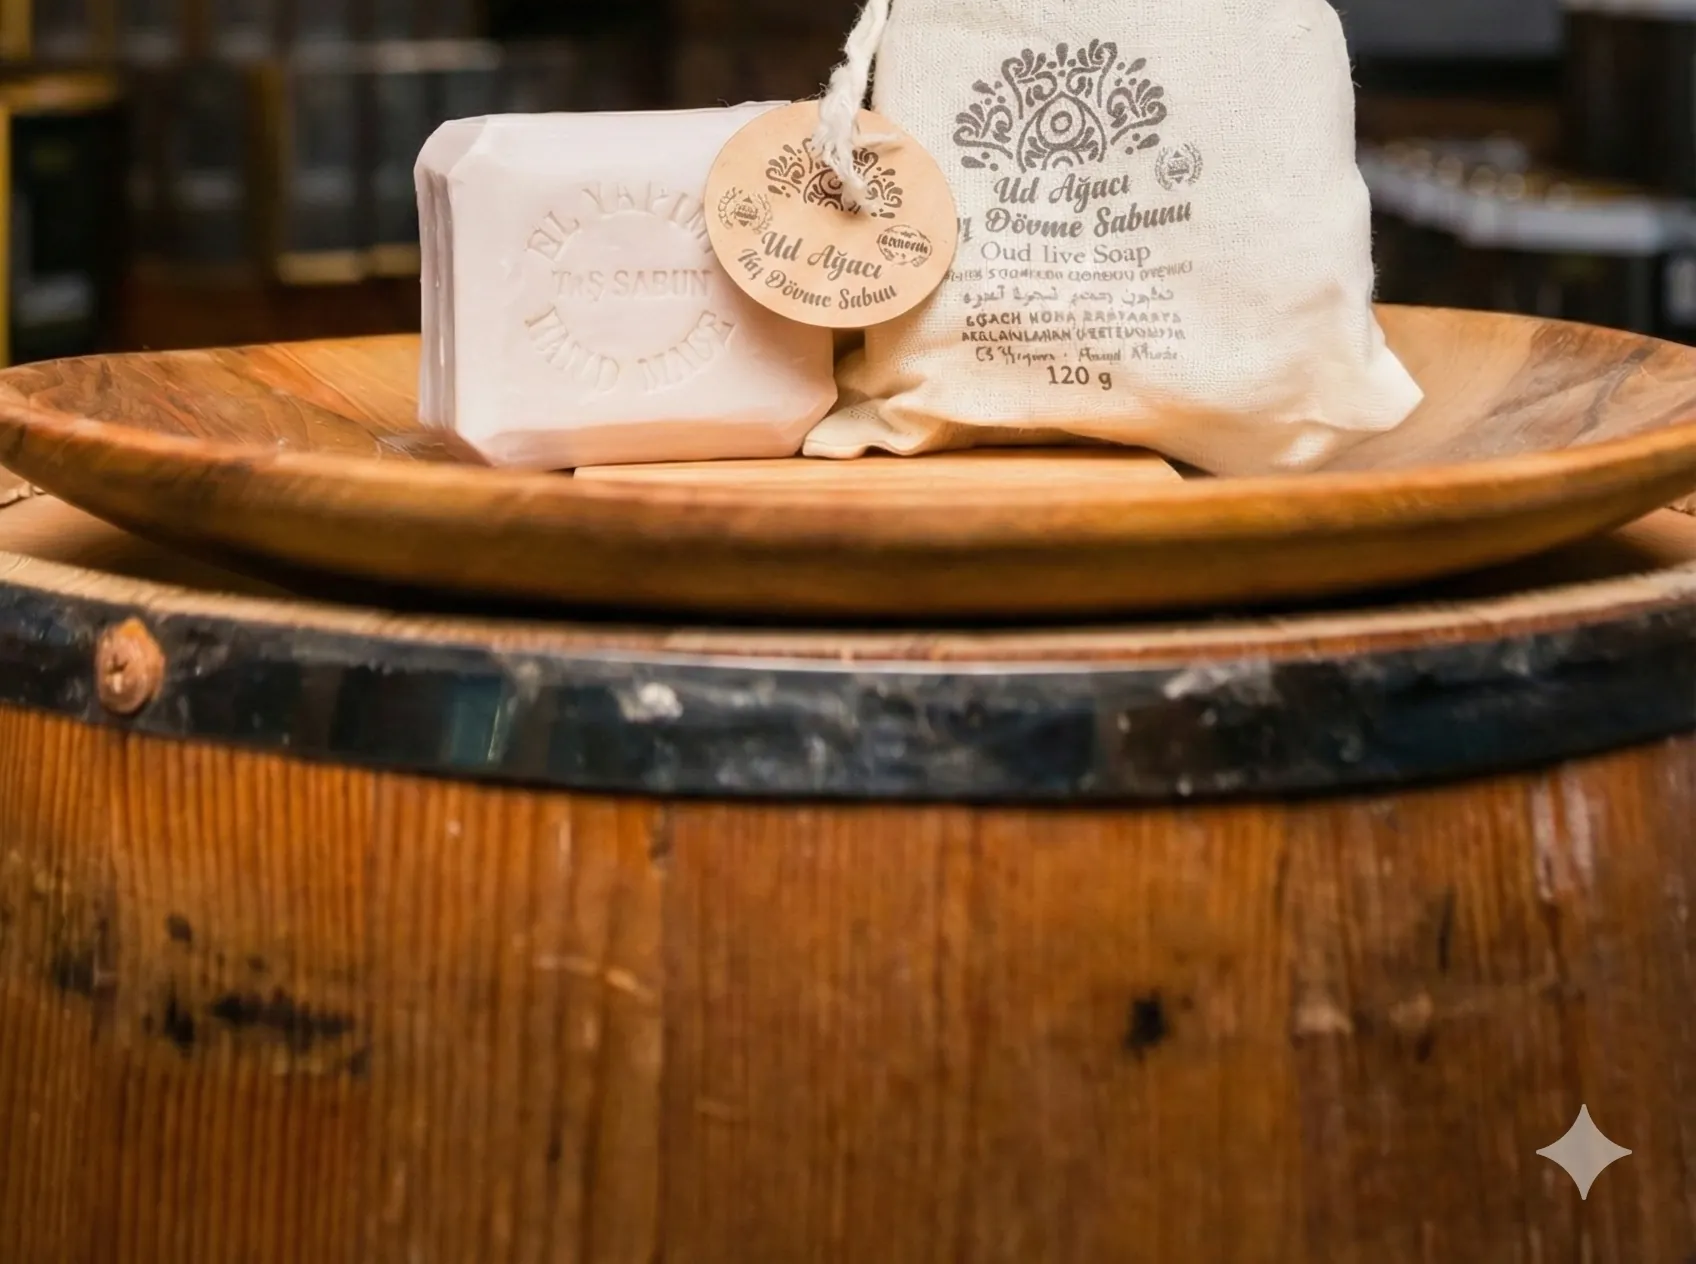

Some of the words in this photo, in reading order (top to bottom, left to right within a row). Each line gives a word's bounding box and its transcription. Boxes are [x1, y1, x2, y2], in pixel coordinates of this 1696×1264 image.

[993, 176, 1040, 204] Ud
[1048, 173, 1131, 213] Ağacı
[985, 207, 1083, 238] Dövme
[1093, 201, 1192, 238] Sabunu
[761, 231, 804, 262] Ud
[806, 244, 882, 282] Ağacı
[980, 241, 1032, 262] Oud
[1093, 244, 1151, 268] Soap
[1046, 365, 1089, 385] 120
[1098, 372, 1113, 390] g
